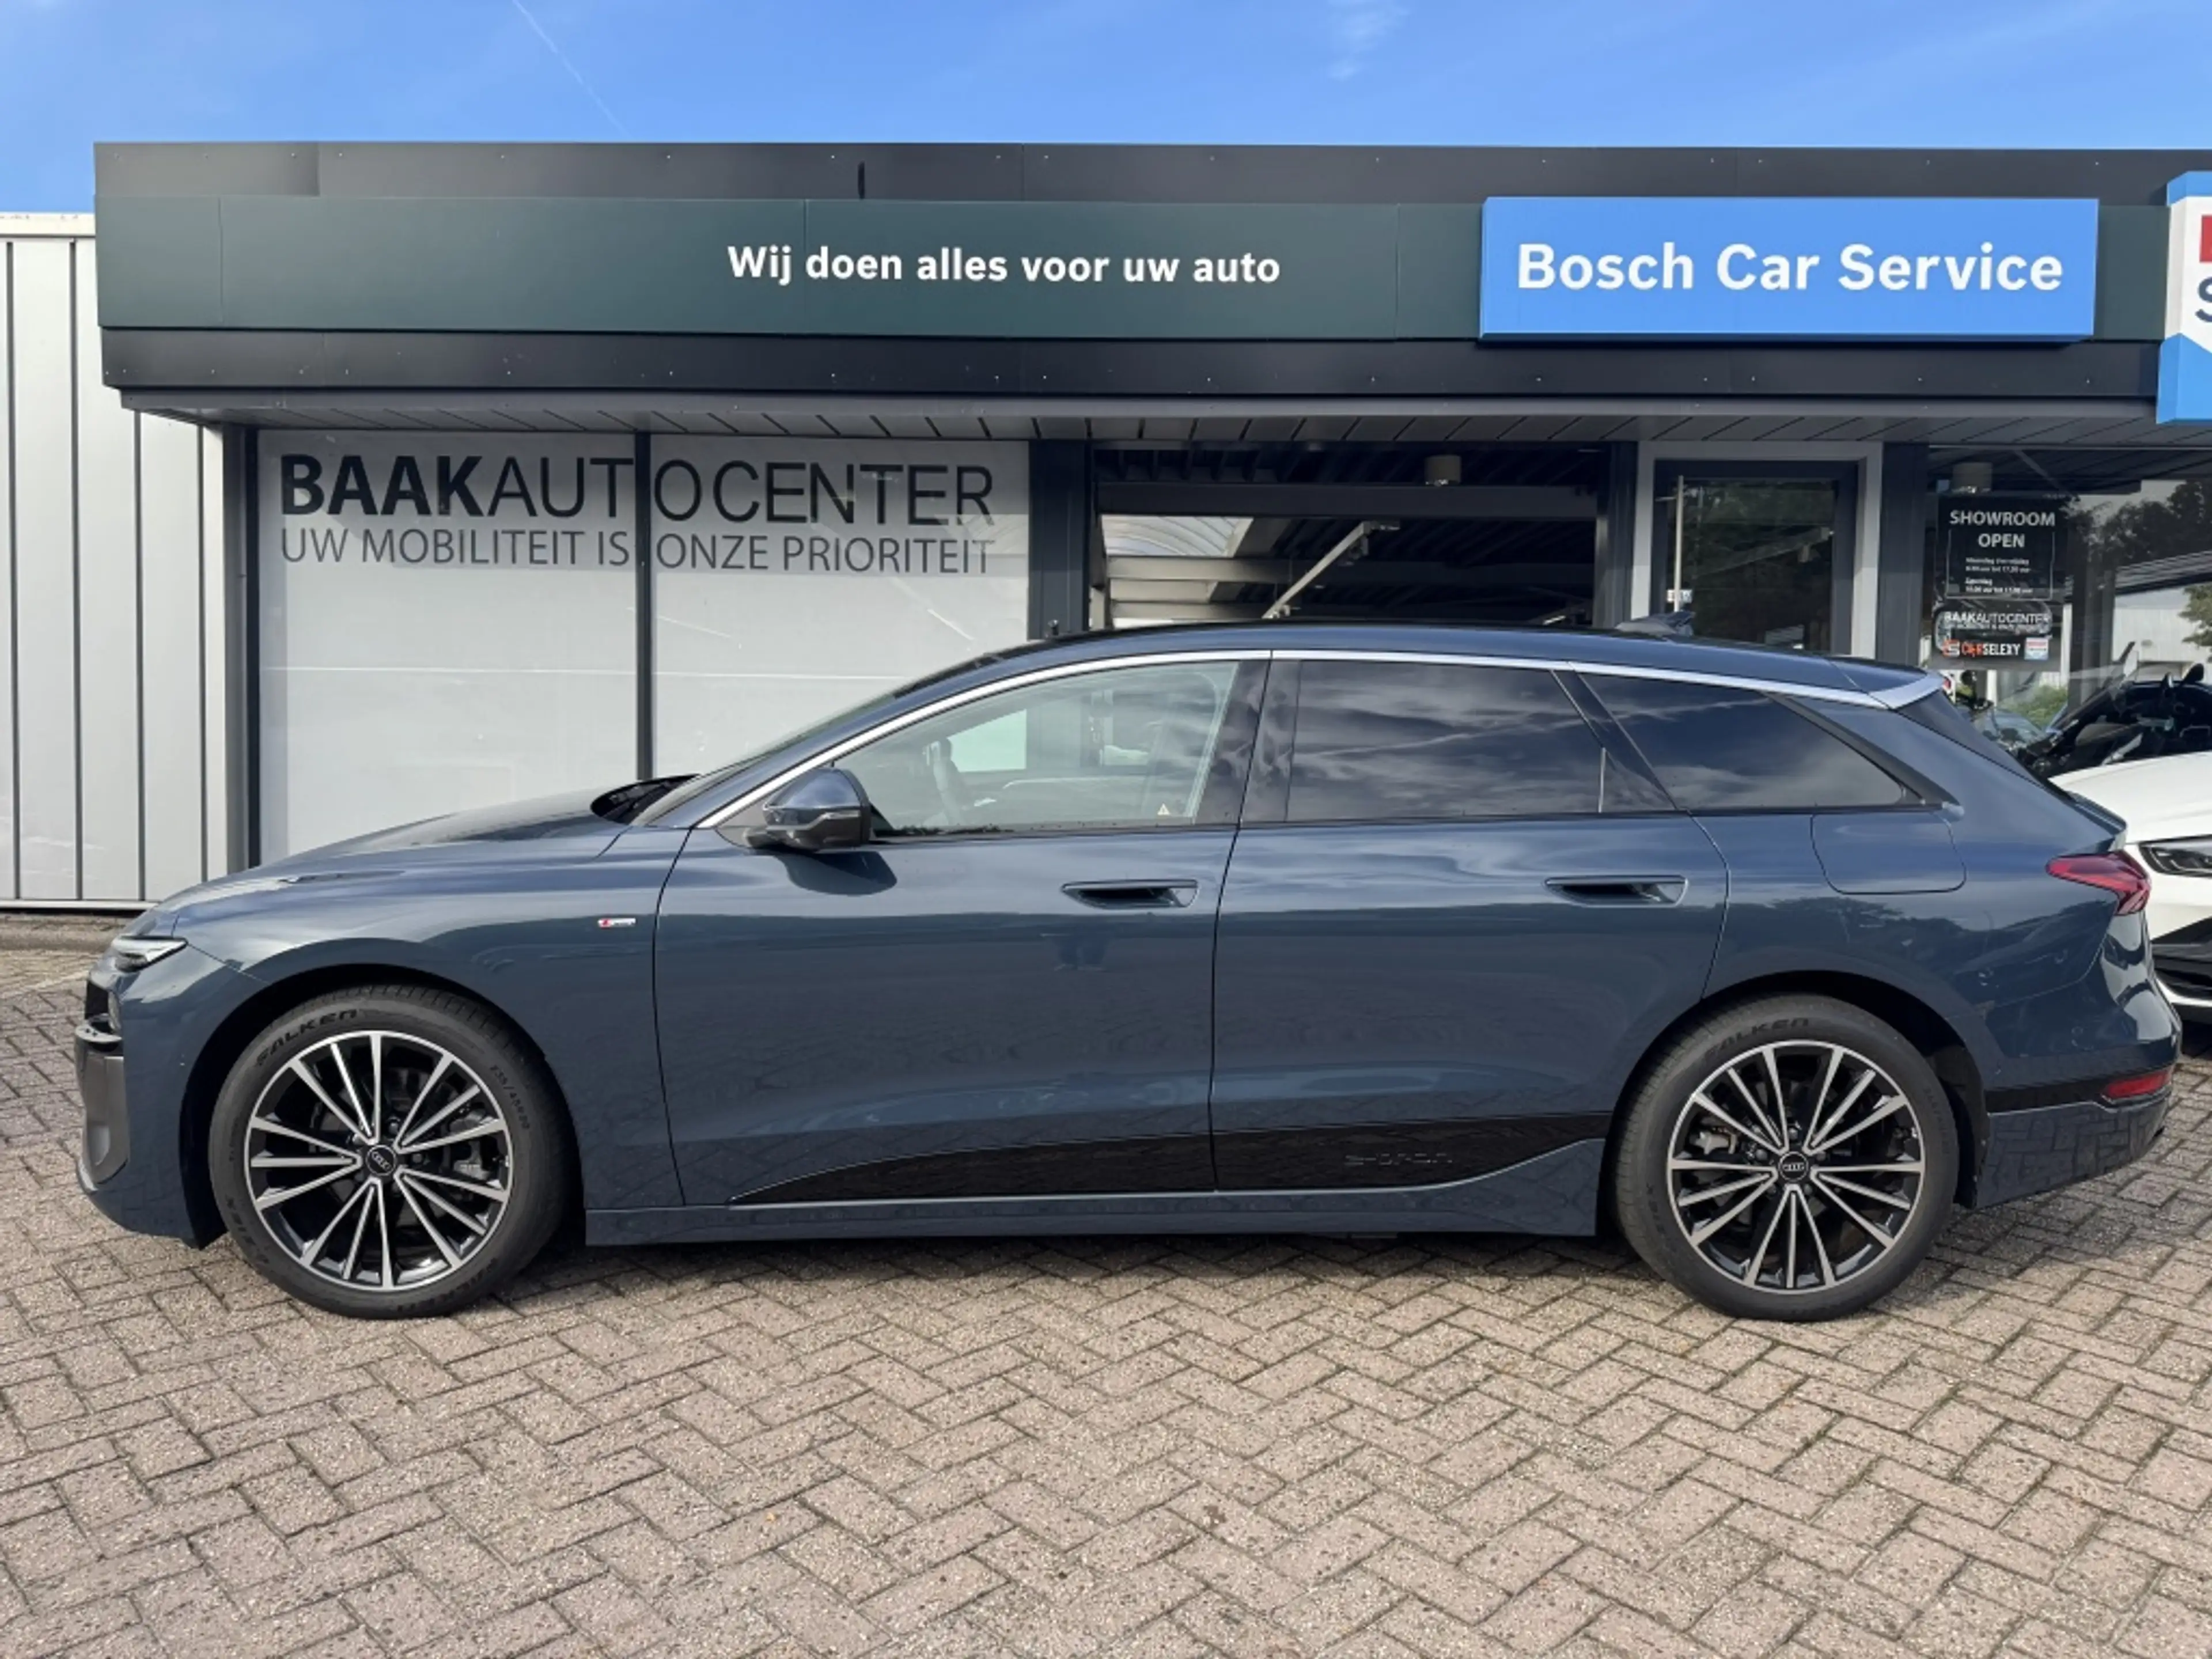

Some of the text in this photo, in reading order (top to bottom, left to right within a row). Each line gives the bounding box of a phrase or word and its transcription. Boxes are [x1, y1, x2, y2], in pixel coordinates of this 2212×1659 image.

[728, 246, 1280, 287] Wij doen alles voor uw auto
[1518, 242, 2063, 290] Bosch Car Service
[1949, 510, 2055, 527] SHOWROOM
[282, 528, 995, 574] UW MOBILITEIT IS ONZE PRIORITEIT
[1978, 533, 2025, 548] OPEN
